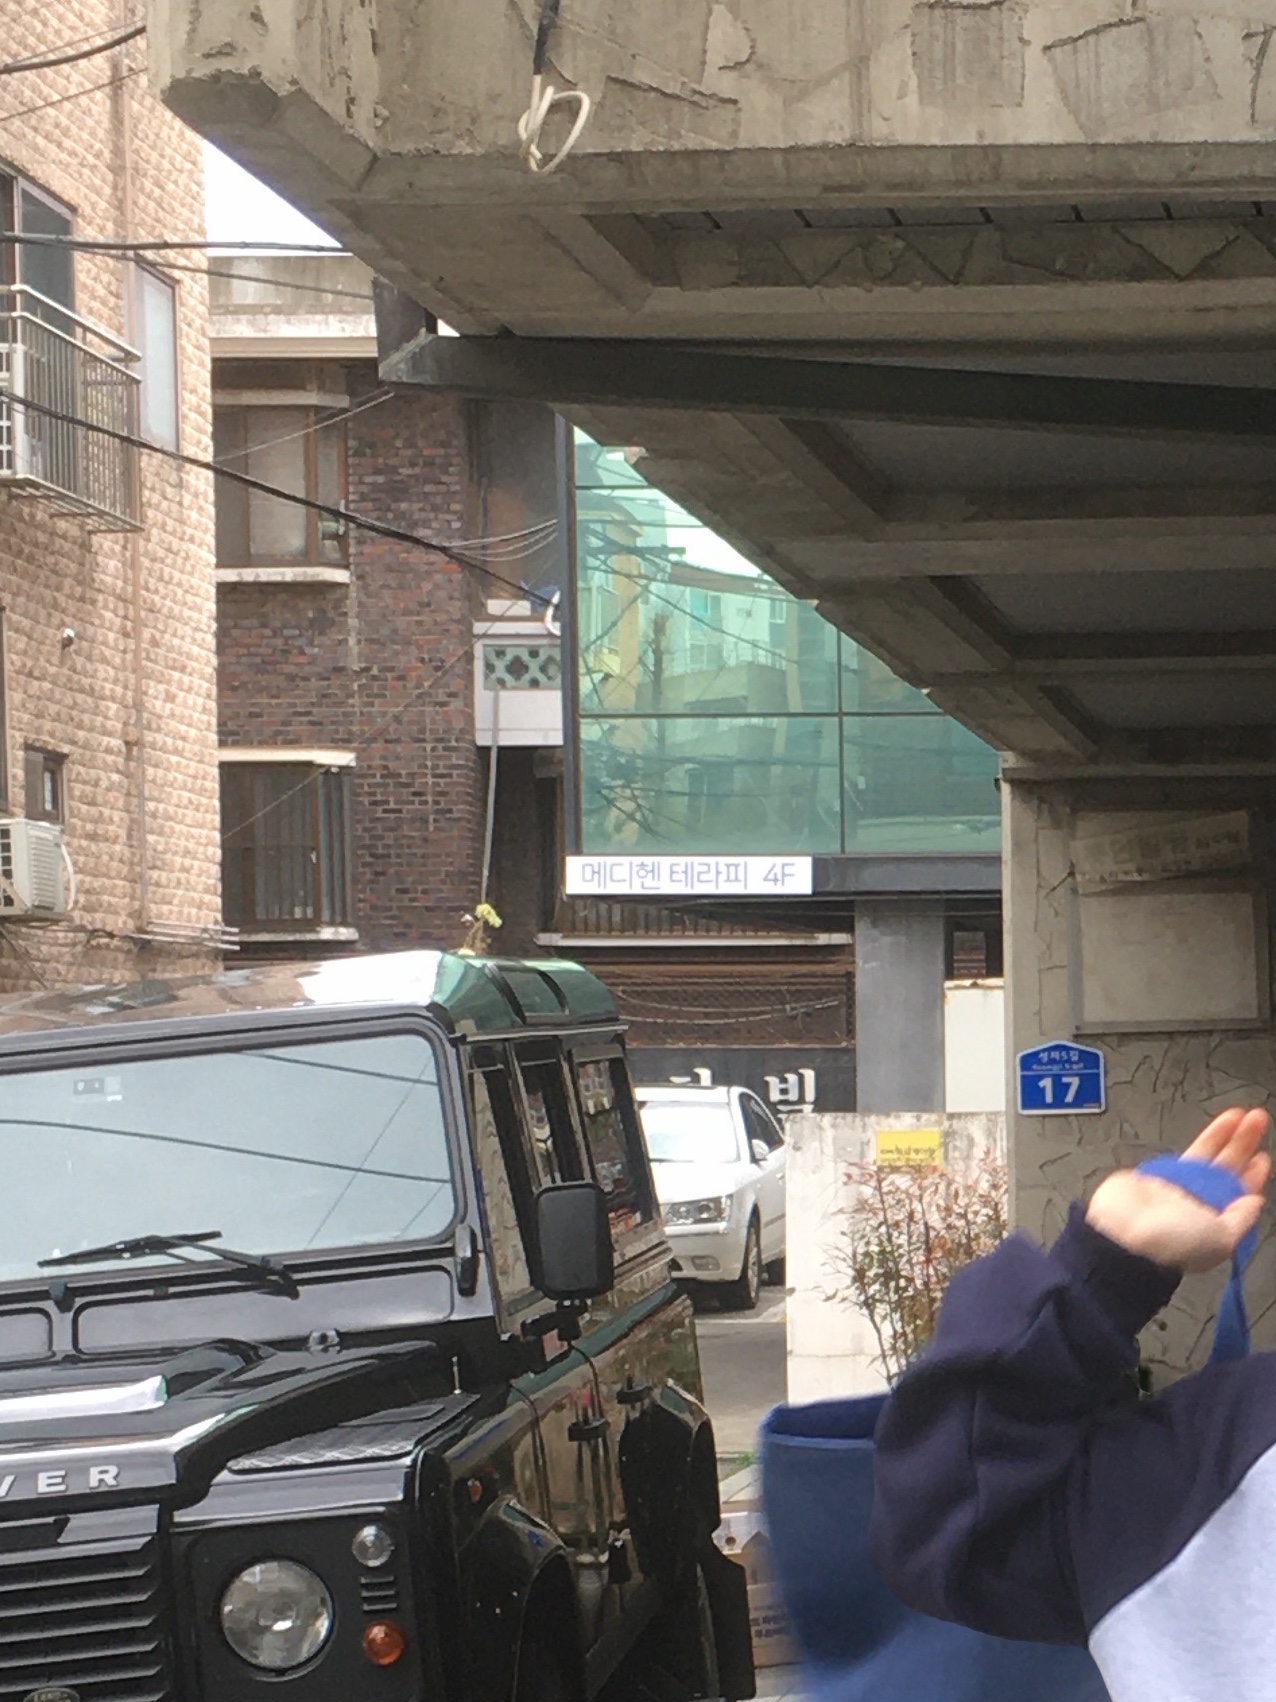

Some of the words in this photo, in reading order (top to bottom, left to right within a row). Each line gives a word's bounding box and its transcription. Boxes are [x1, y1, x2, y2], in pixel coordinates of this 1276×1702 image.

[581, 860, 661, 890] 메디헨
[669, 860, 749, 890] 테라피
[762, 862, 796, 887] 4F
[1037, 1076, 1081, 1104] 17
